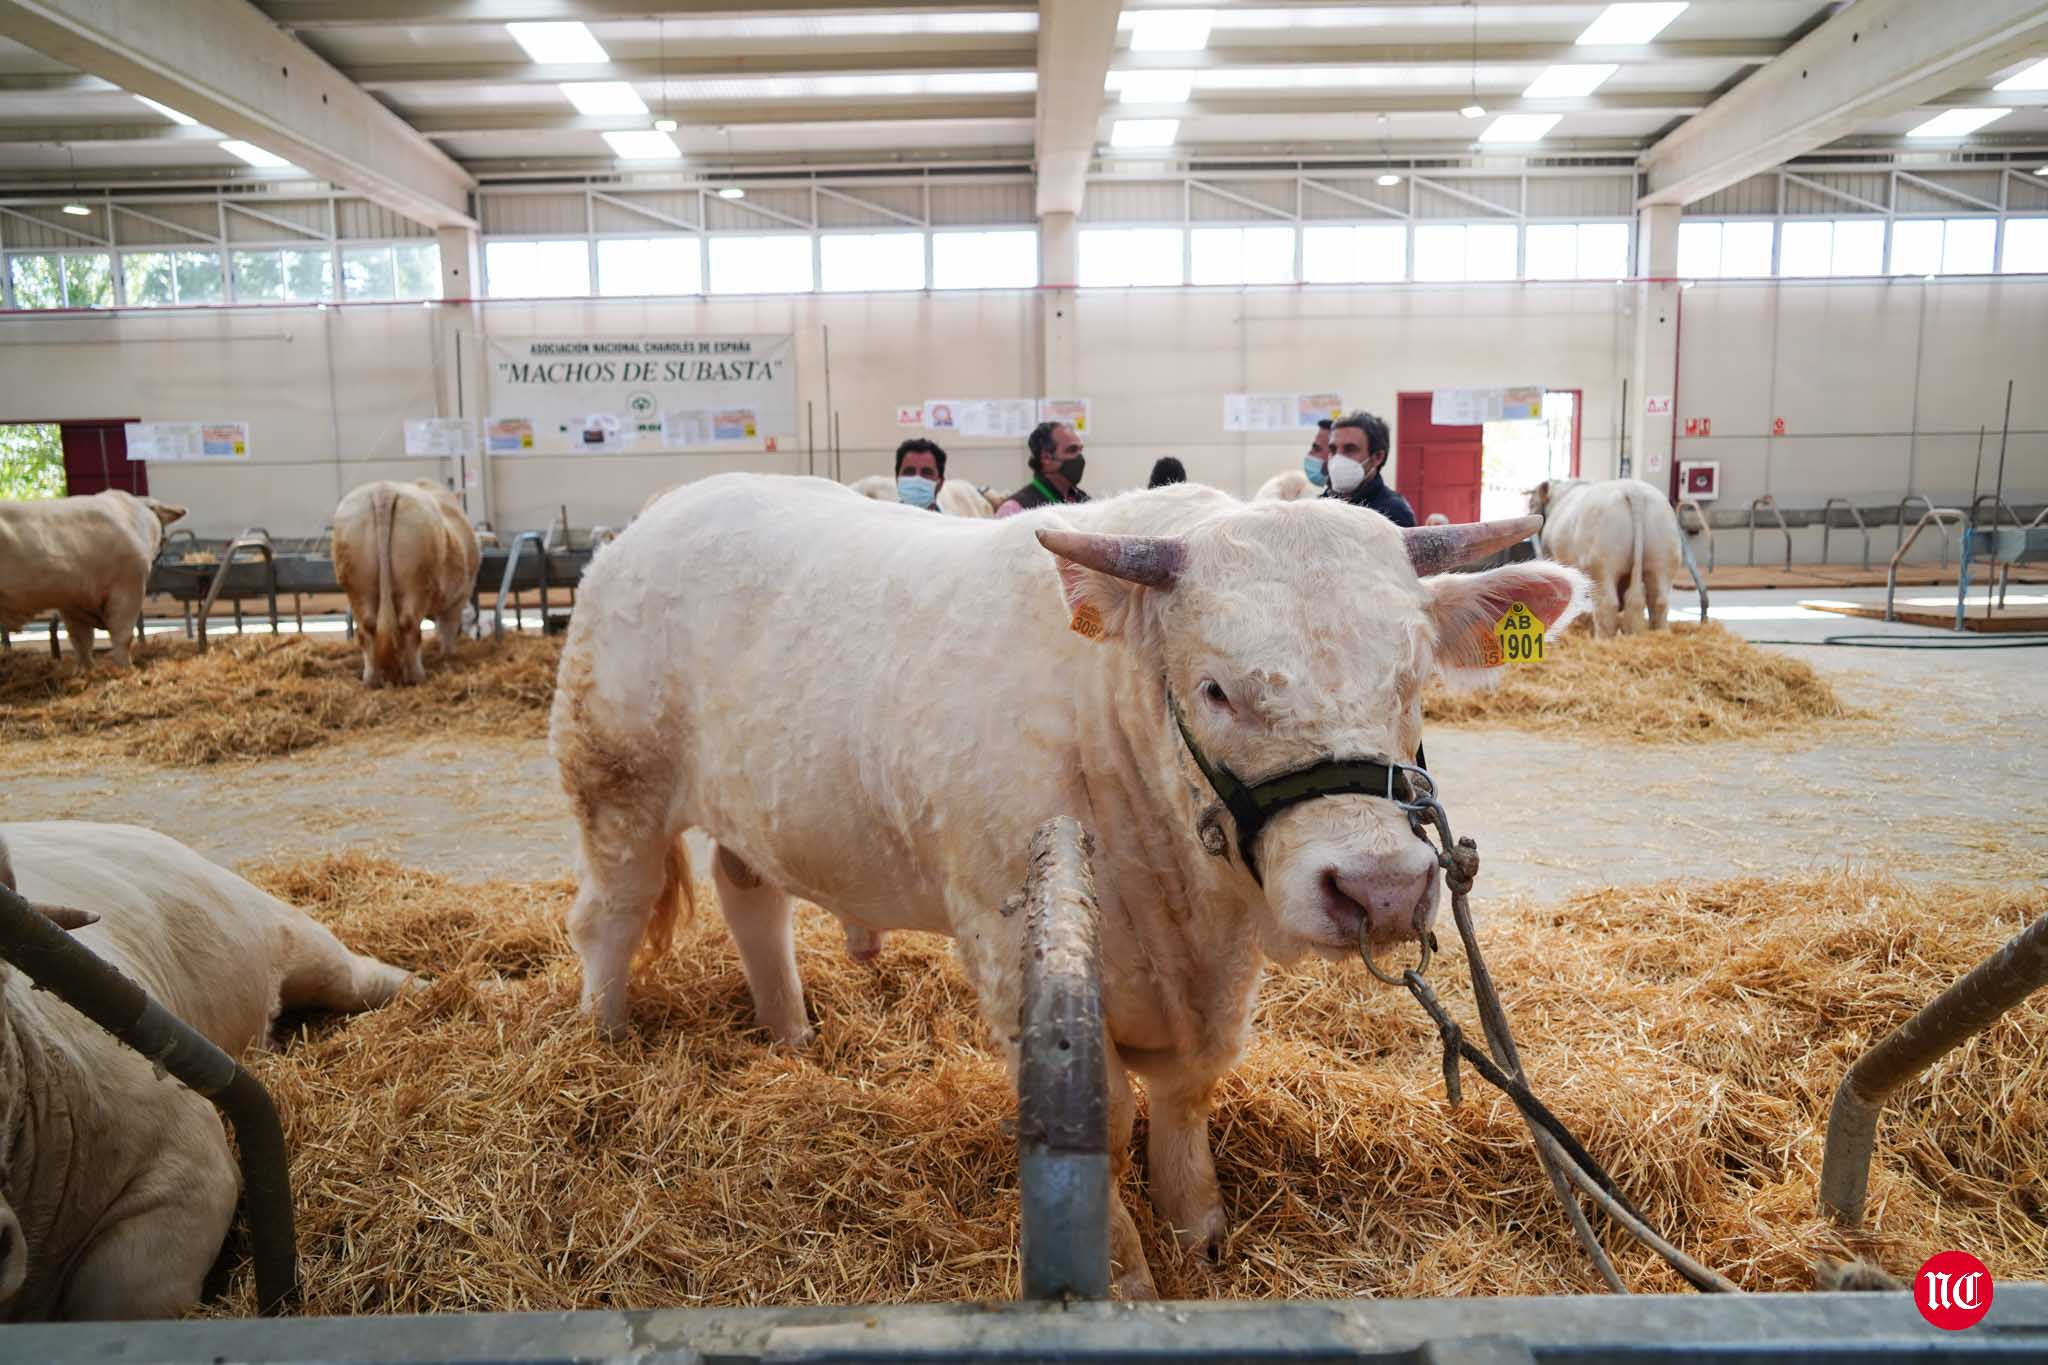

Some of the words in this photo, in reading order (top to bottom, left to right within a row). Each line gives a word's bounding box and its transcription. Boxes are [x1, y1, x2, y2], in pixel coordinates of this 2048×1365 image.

[592, 343, 641, 353] NACIONAL
[697, 343, 710, 353] DE
[713, 340, 752, 353] ESPAÑA
[499, 361, 617, 384] "MACHOS
[622, 361, 660, 383] DE
[663, 360, 783, 382] SUBASTA"
[1504, 615, 1532, 630] AB
[1500, 633, 1544, 659] 1901
